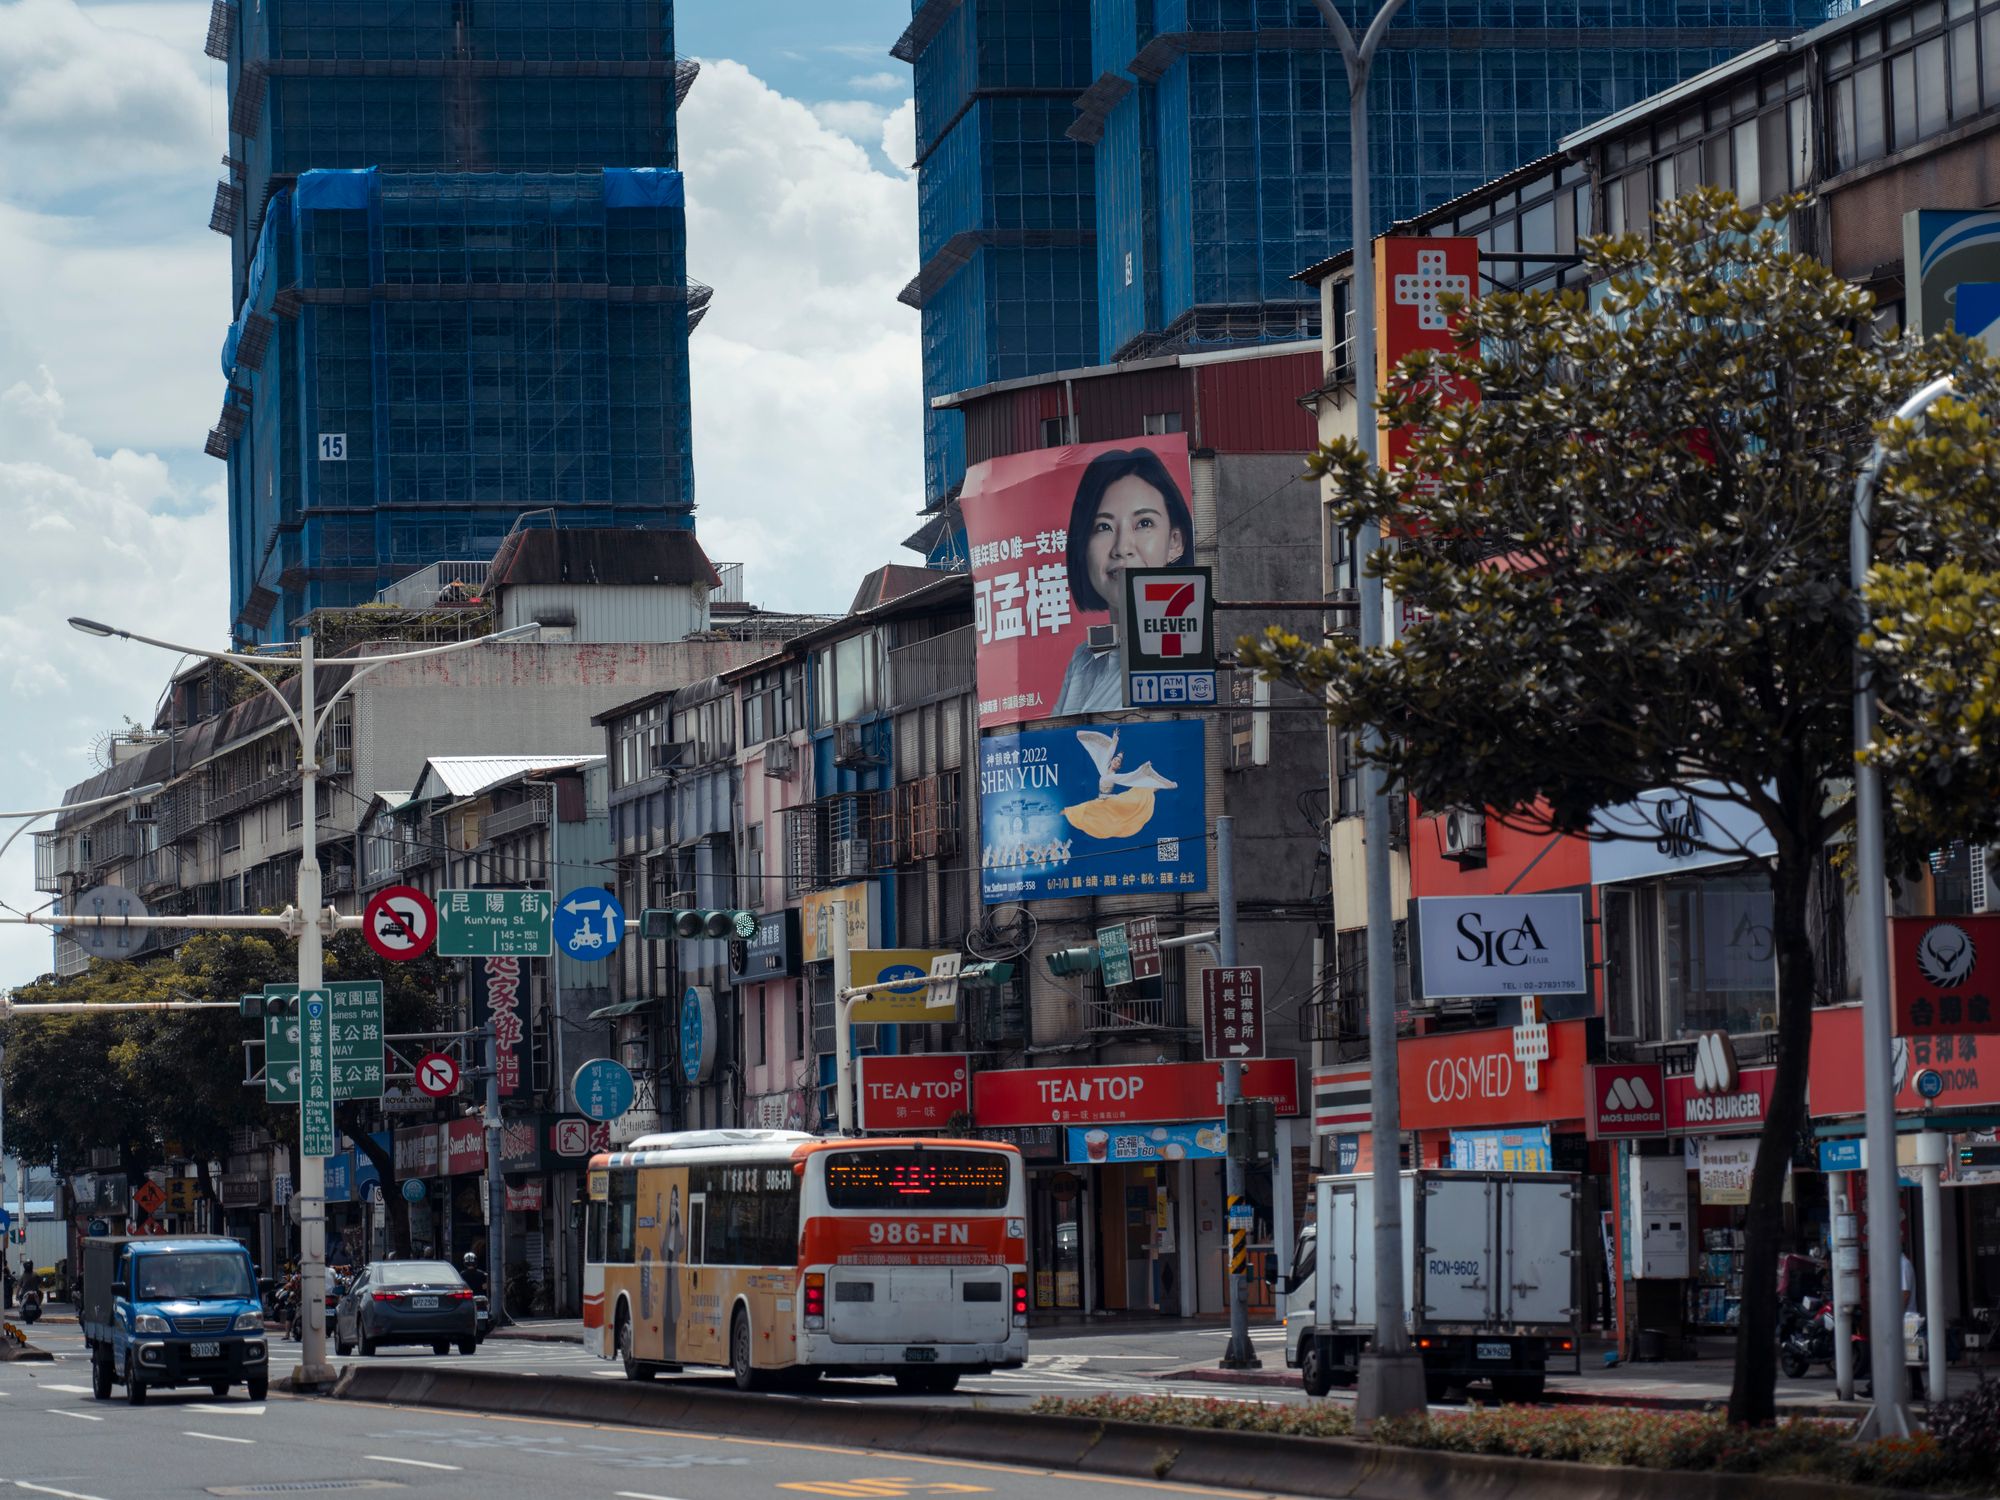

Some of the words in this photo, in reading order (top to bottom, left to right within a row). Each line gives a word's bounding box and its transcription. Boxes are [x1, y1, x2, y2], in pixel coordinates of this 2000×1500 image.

[322, 436, 343, 457] 15
[1163, 676, 1184, 687] ATM
[1022, 747, 1047, 762] 2022
[981, 769, 1014, 794] SHEN
[1017, 763, 1059, 790] YUN
[452, 894, 539, 912] 昆陽街
[464, 916, 507, 926] KunYang
[501, 931, 514, 939] 145
[1456, 912, 1548, 967] SICA
[501, 943, 514, 951] 136
[524, 943, 538, 951] 138
[312, 1006, 318, 1014] 5
[361, 1009, 379, 1019] Park
[1222, 971, 1236, 1039] 所長宿舍
[1240, 970, 1254, 1039] 松山療養所
[309, 1020, 323, 1099] 忠孝東路六段
[1427, 1053, 1512, 1103] COSMED
[868, 1083, 908, 1099] TEA
[922, 1082, 962, 1098] TOP
[1037, 1079, 1078, 1103] TEA
[1093, 1076, 1144, 1101] TOP
[306, 1100, 329, 1109] Zhong
[1686, 1098, 1712, 1122] MOS
[1715, 1093, 1761, 1118] BURGER
[1601, 1114, 1622, 1122] MOS
[1624, 1113, 1660, 1122] BURGER
[467, 1133, 481, 1156] Shop
[766, 1170, 792, 1190] 986-FN
[869, 1223, 969, 1244] 986-FN
[1429, 1260, 1479, 1276] RCN-9602
